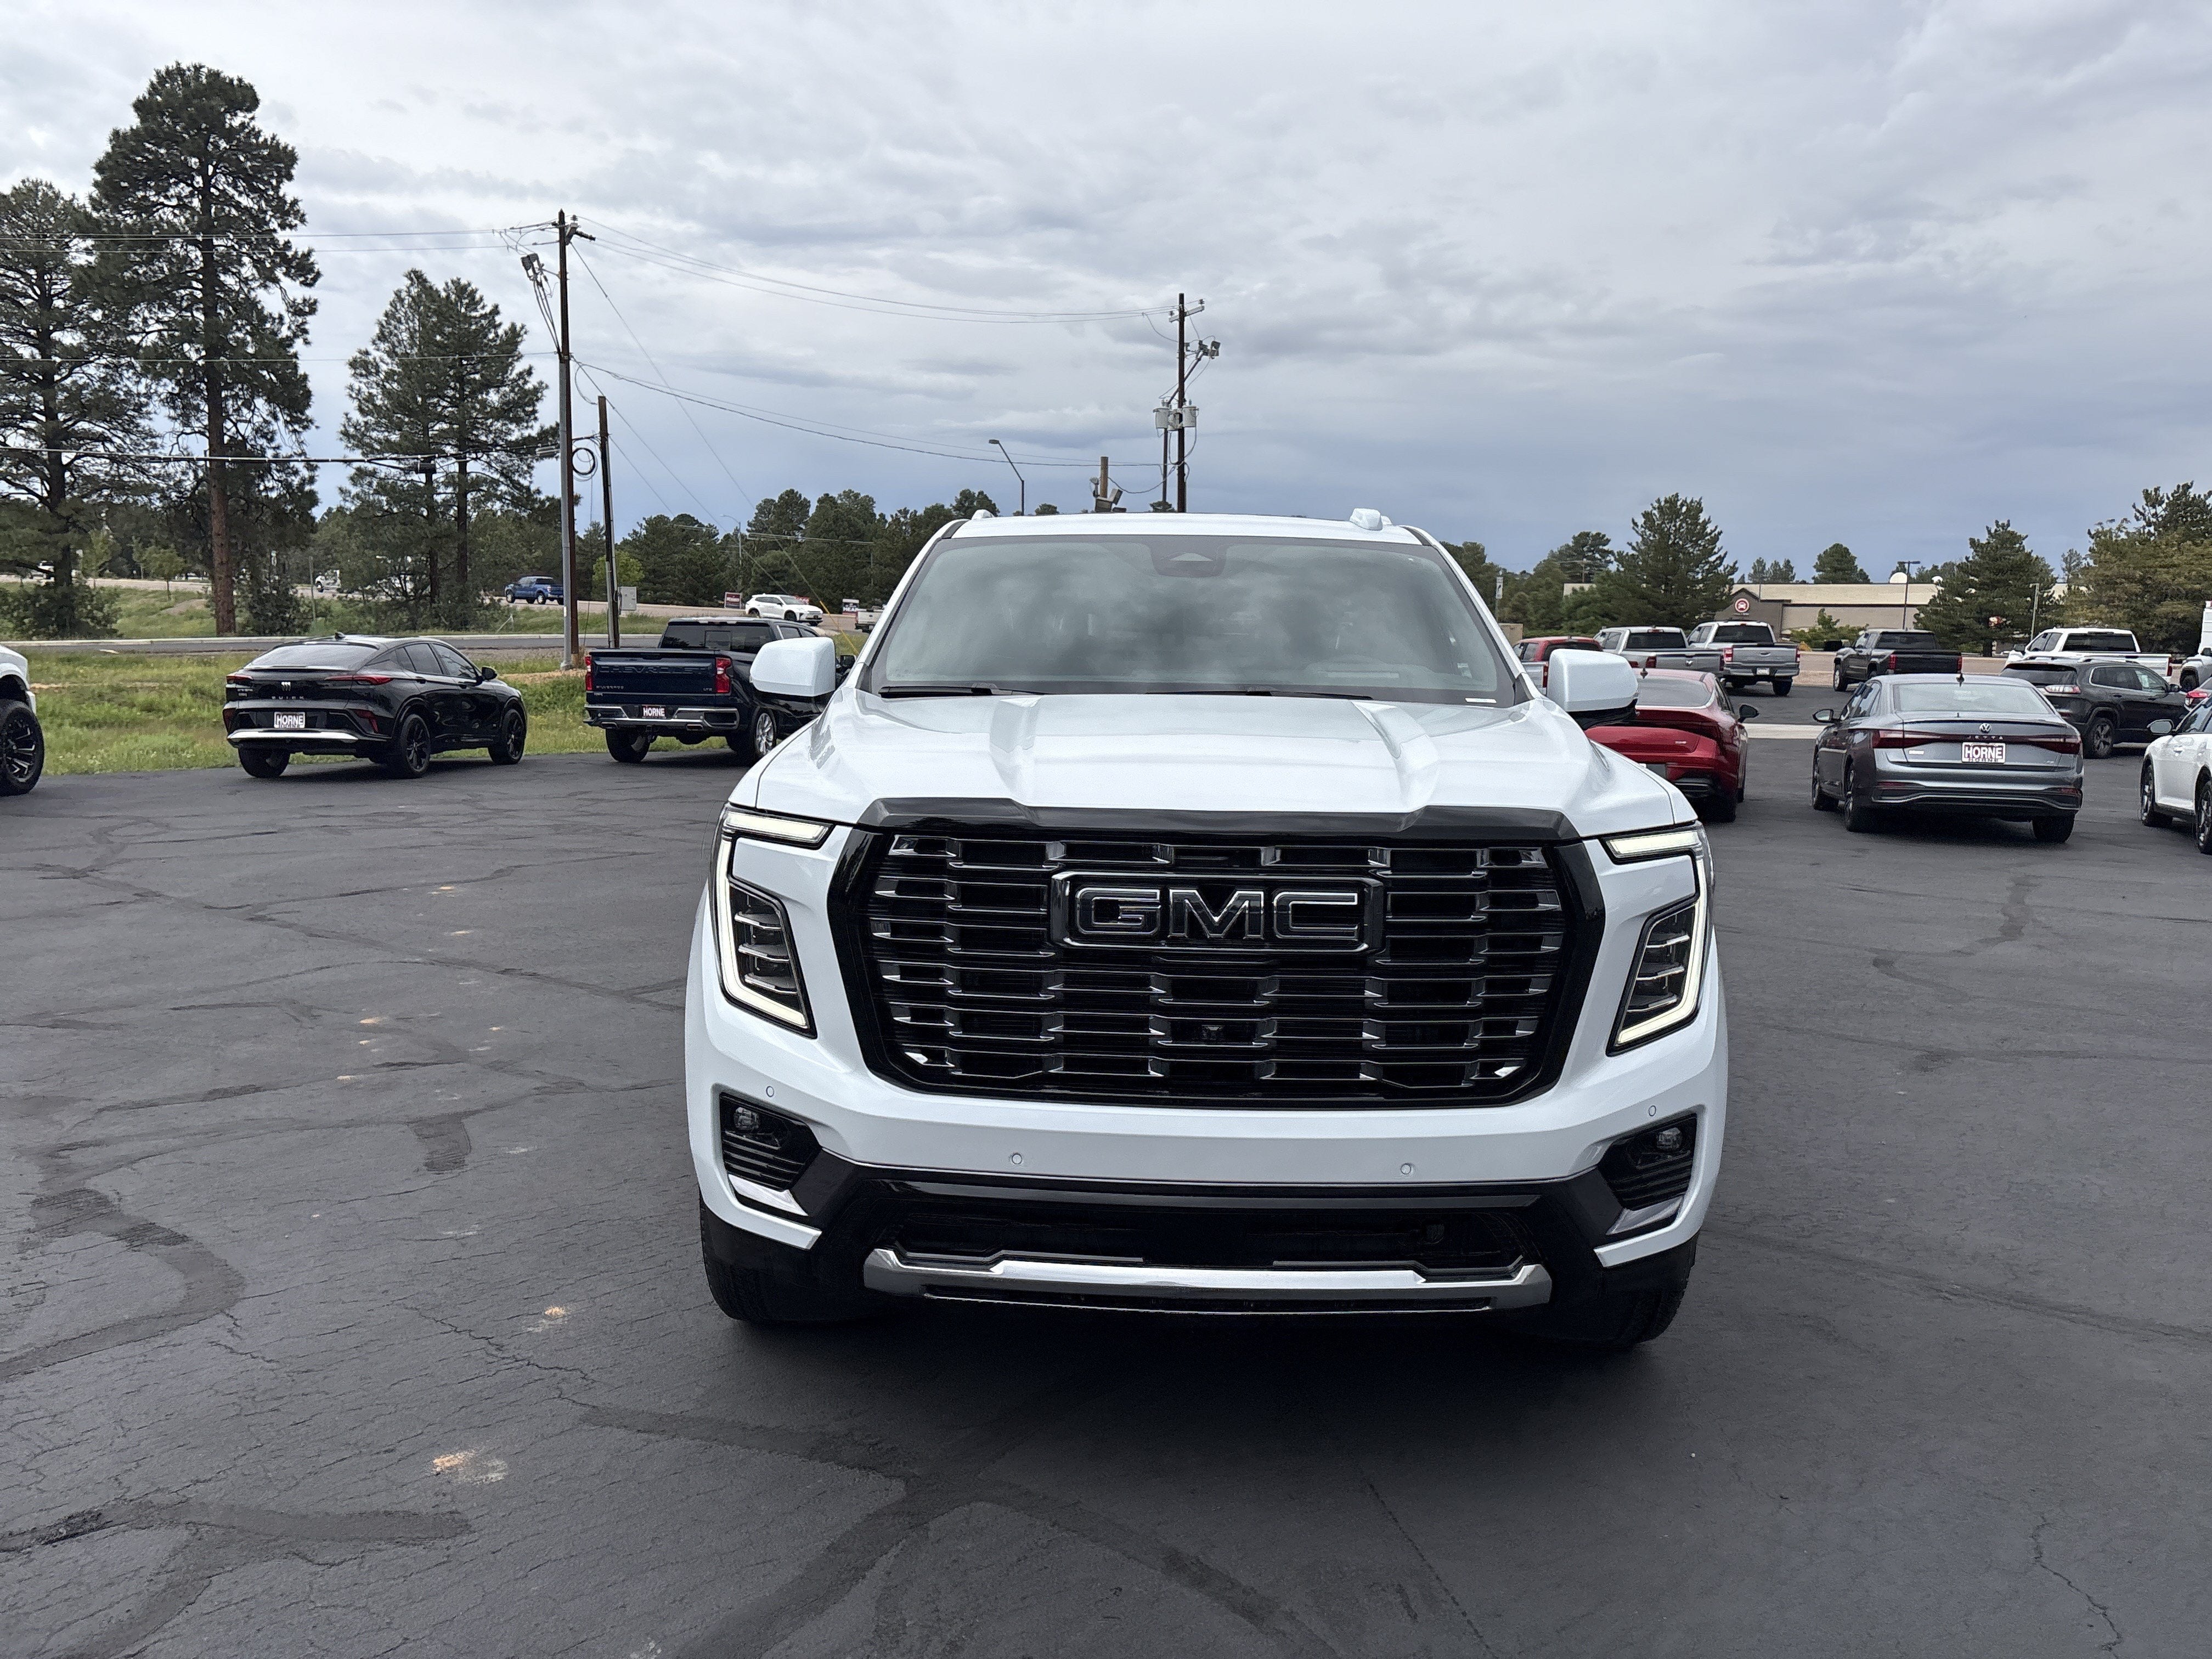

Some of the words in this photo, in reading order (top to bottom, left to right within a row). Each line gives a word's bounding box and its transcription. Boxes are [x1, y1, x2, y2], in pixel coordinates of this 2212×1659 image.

[643, 706, 665, 716] HORNE
[276, 714, 303, 725] HORNE
[1965, 746, 2002, 759] HORNE
[1074, 887, 1359, 941] GMC
